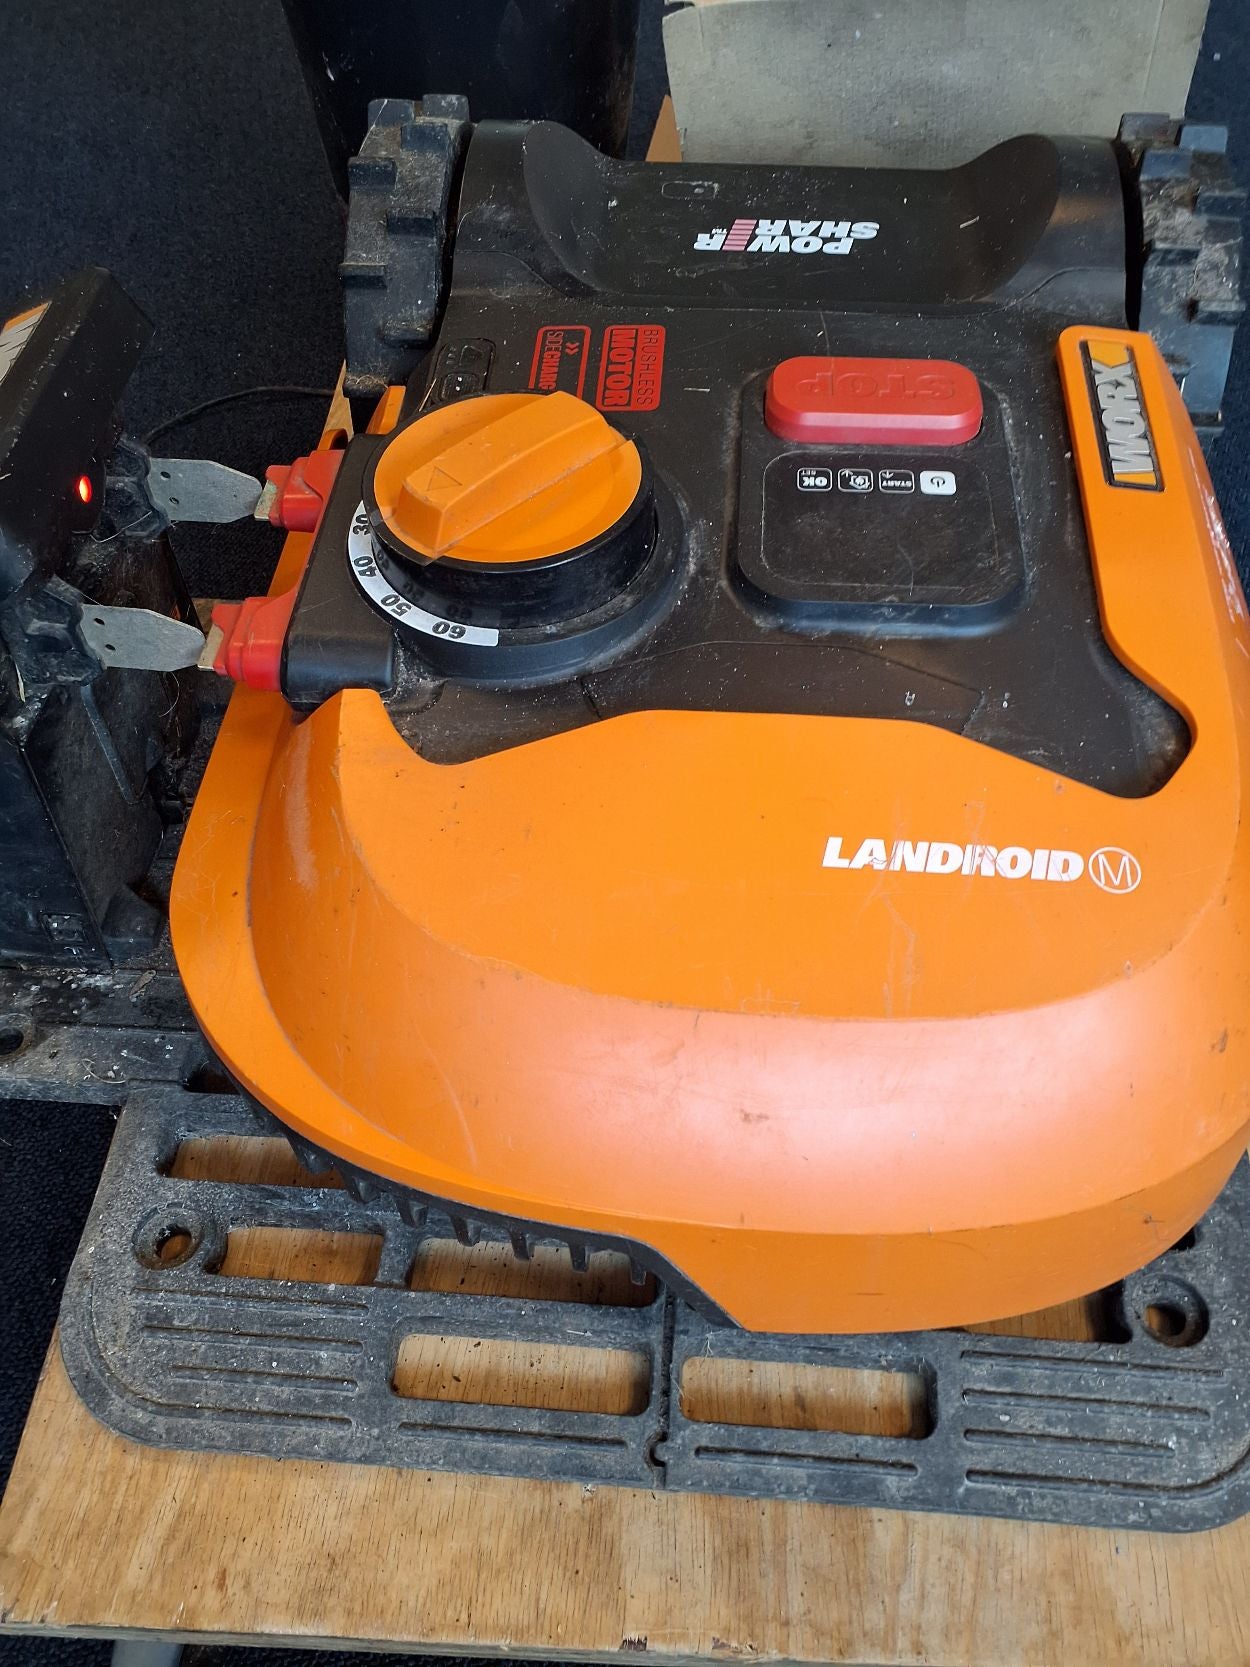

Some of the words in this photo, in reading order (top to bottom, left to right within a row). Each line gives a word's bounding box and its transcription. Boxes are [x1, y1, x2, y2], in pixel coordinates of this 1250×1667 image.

[538, 331, 564, 390] SIDECHARG
[603, 329, 636, 406] MOTOR
[636, 329, 659, 406] BRUSHLESS
[796, 371, 955, 398] STOP
[1091, 359, 1154, 474] WORX
[802, 476, 828, 487] OK
[882, 480, 912, 488] START
[352, 513, 371, 536] 30
[353, 555, 377, 578] 40
[380, 594, 412, 617] 50
[431, 621, 466, 639] 60
[822, 837, 1085, 882] LANDROID
[1095, 850, 1135, 890] M
